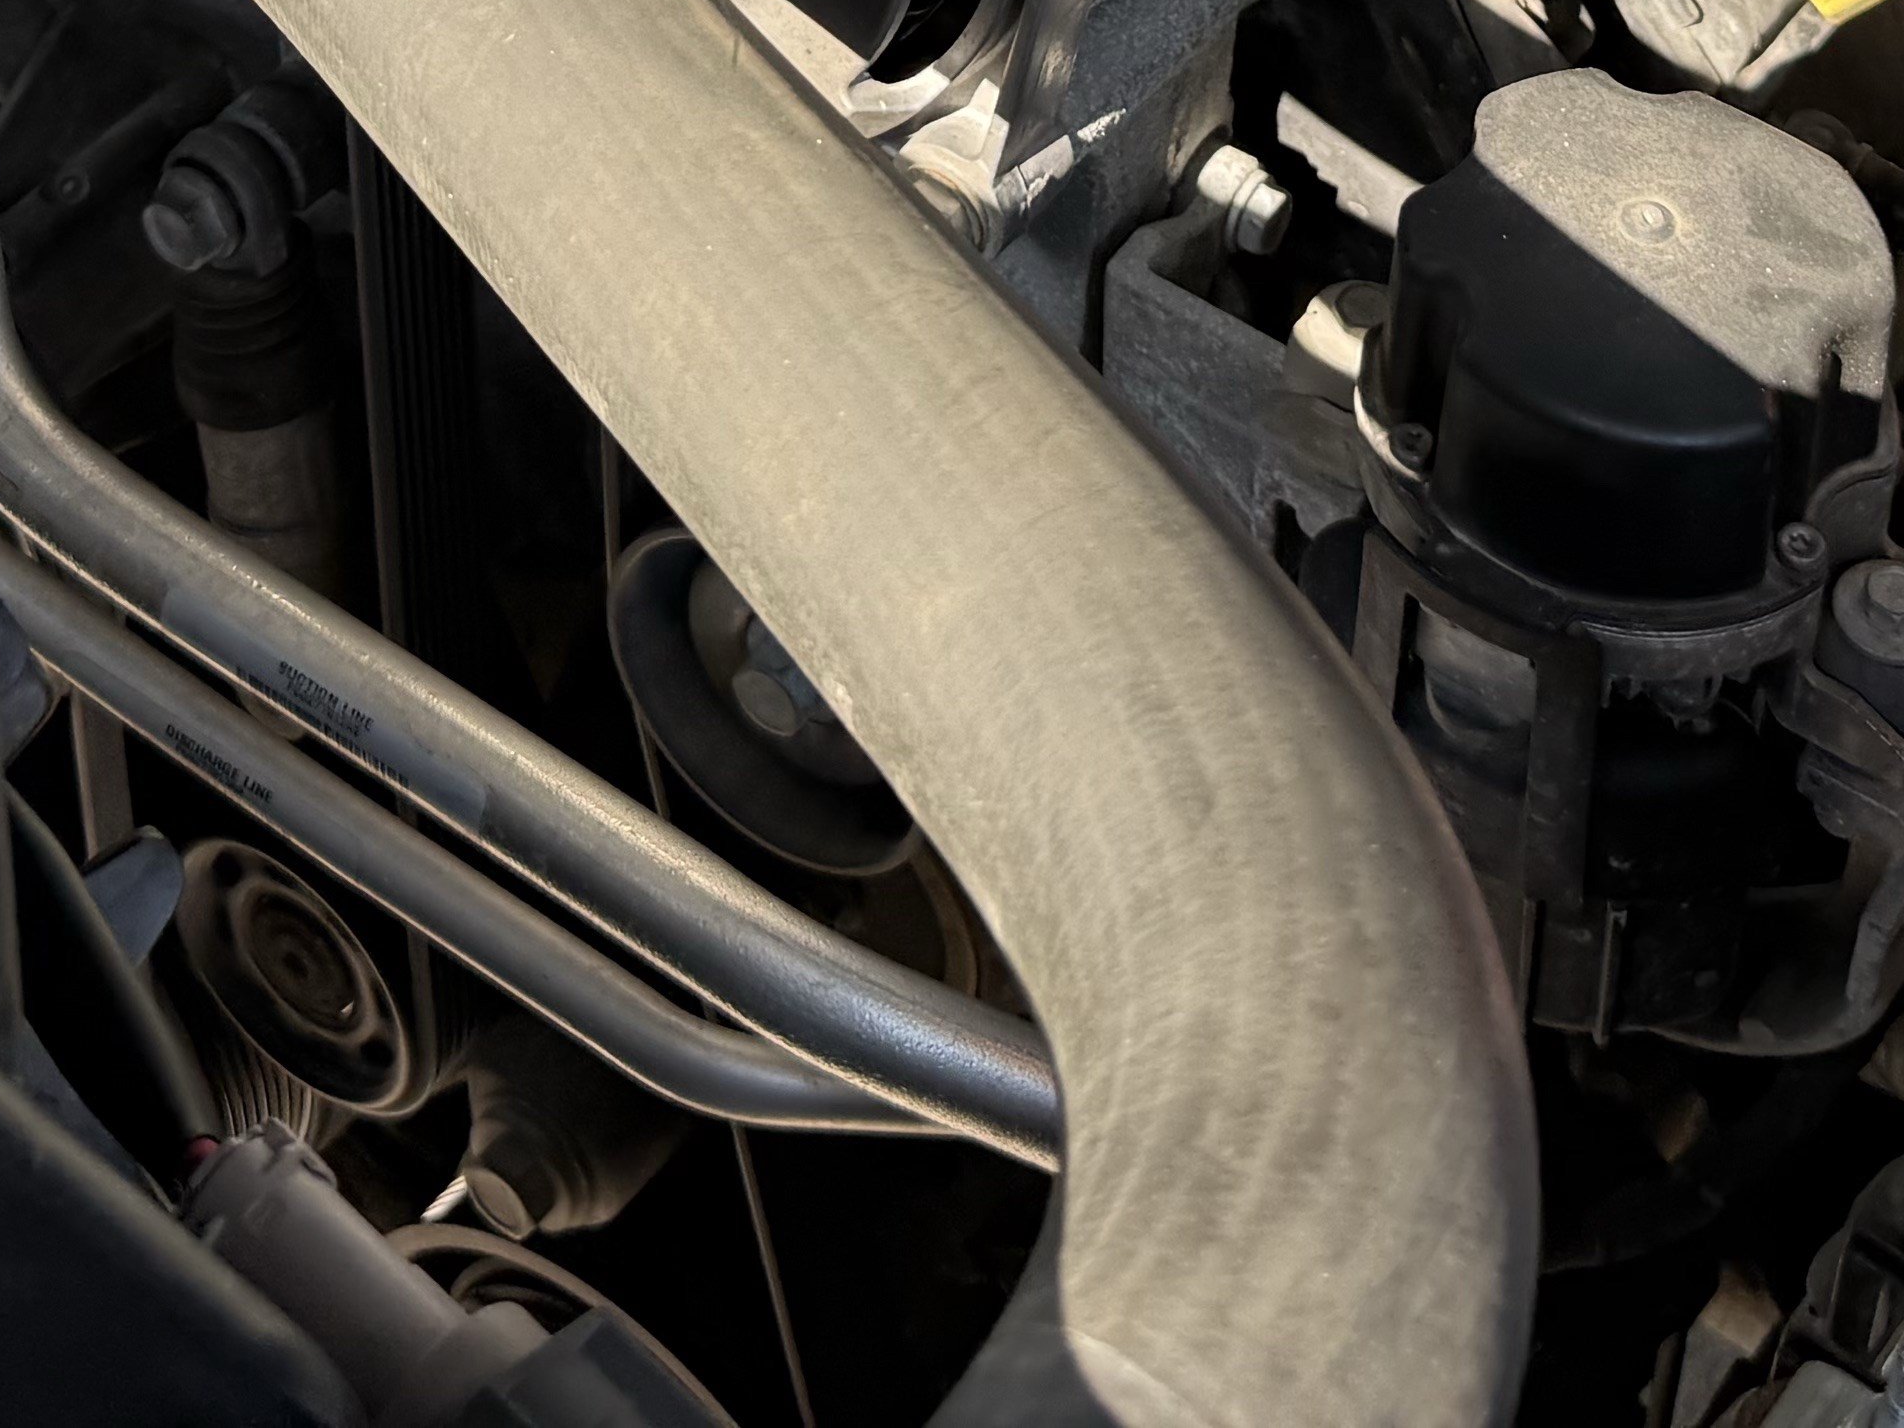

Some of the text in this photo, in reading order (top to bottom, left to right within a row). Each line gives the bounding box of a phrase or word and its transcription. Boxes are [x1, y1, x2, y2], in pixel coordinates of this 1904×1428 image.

[277, 660, 339, 707] SUCTION
[338, 700, 377, 733] LINE
[162, 719, 242, 784] DISCHARGE
[239, 773, 276, 805] LINE
